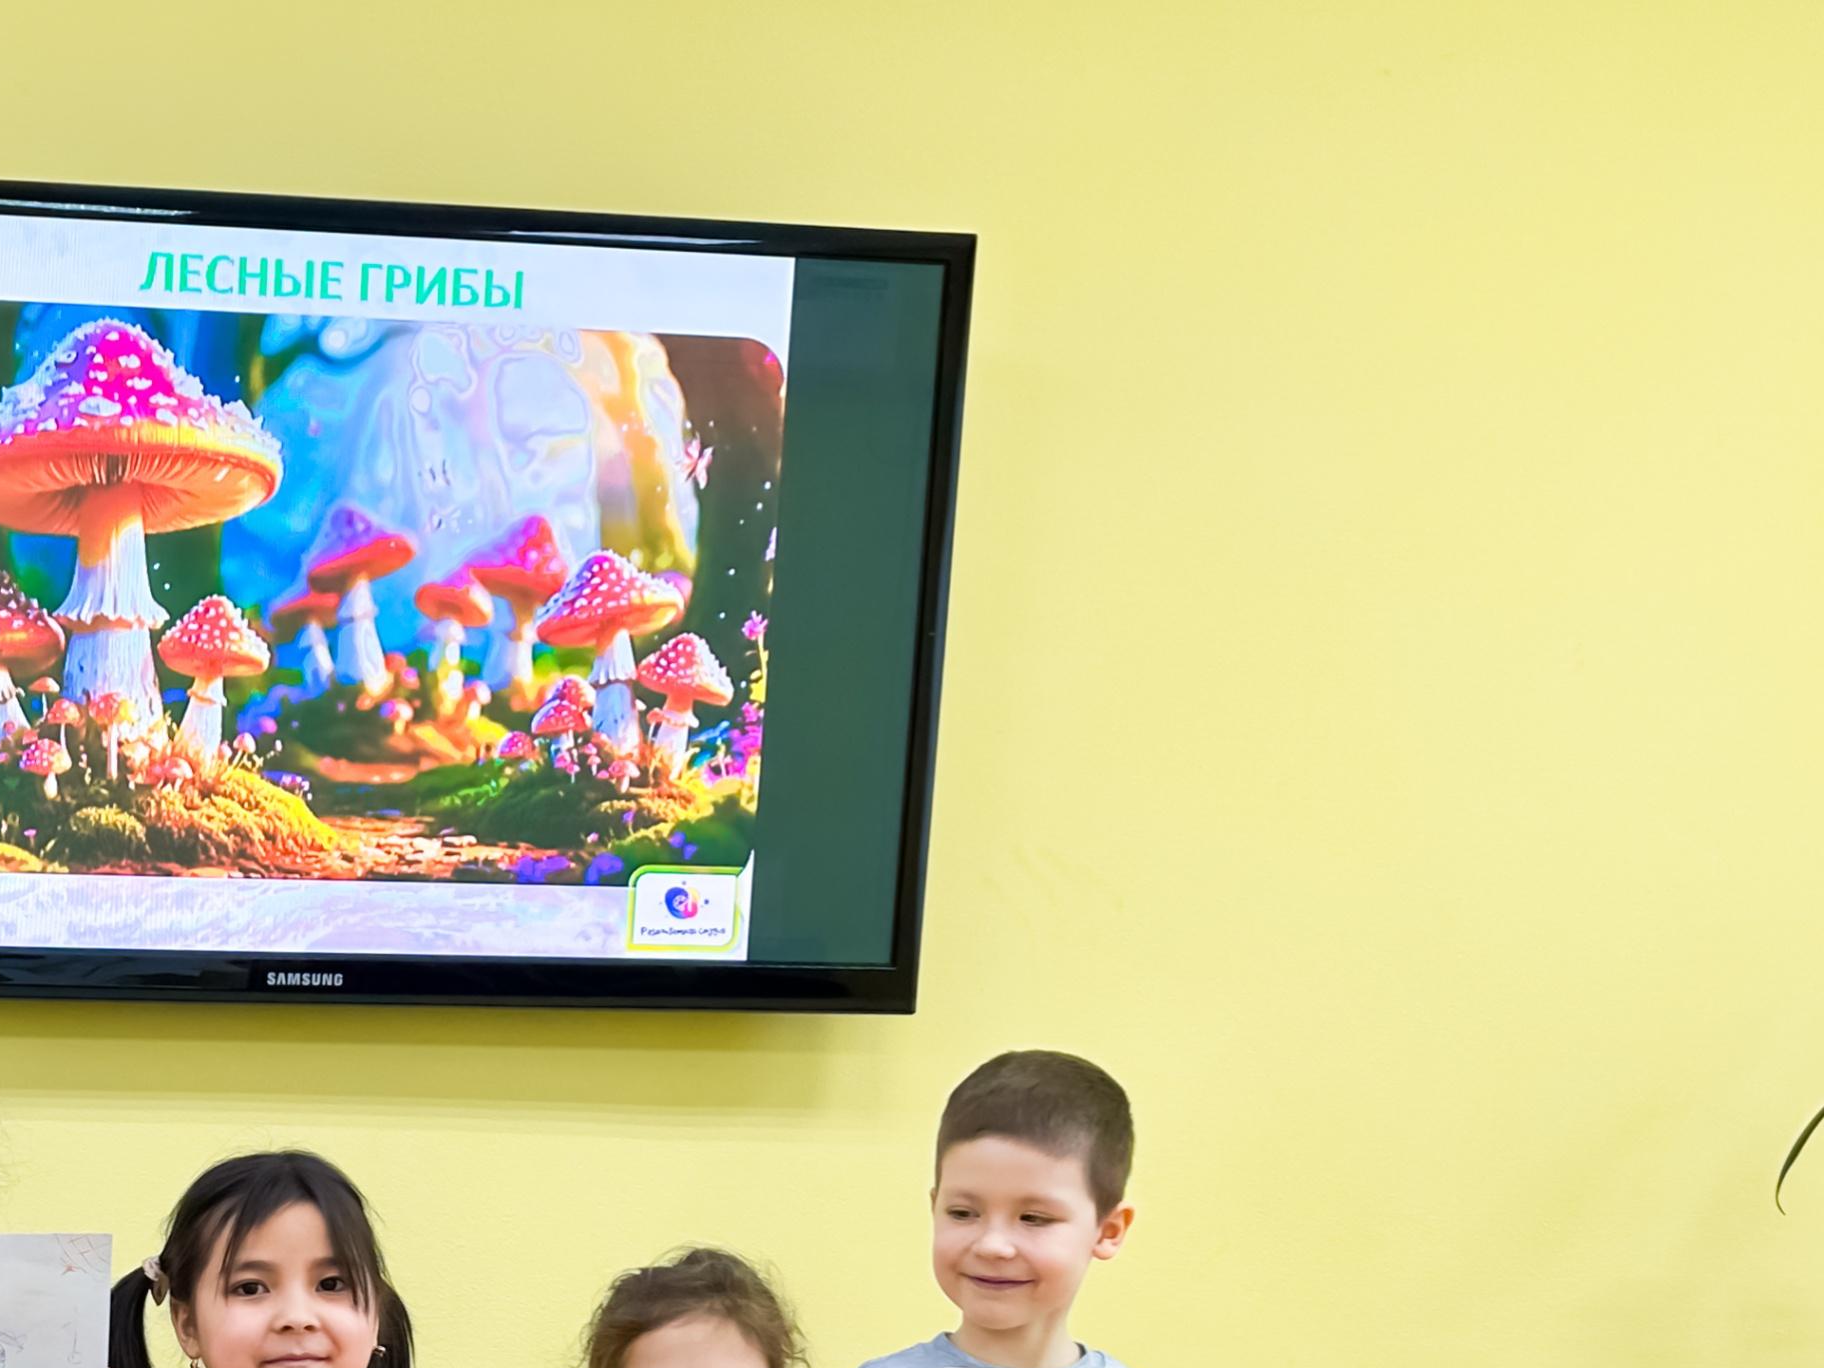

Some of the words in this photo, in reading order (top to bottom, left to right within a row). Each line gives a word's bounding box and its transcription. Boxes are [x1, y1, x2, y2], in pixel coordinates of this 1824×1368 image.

[138, 250, 345, 301] ЛЕСНЫЕ
[359, 262, 525, 310] ГРИБЫ
[266, 971, 344, 987] SAMSUNG
